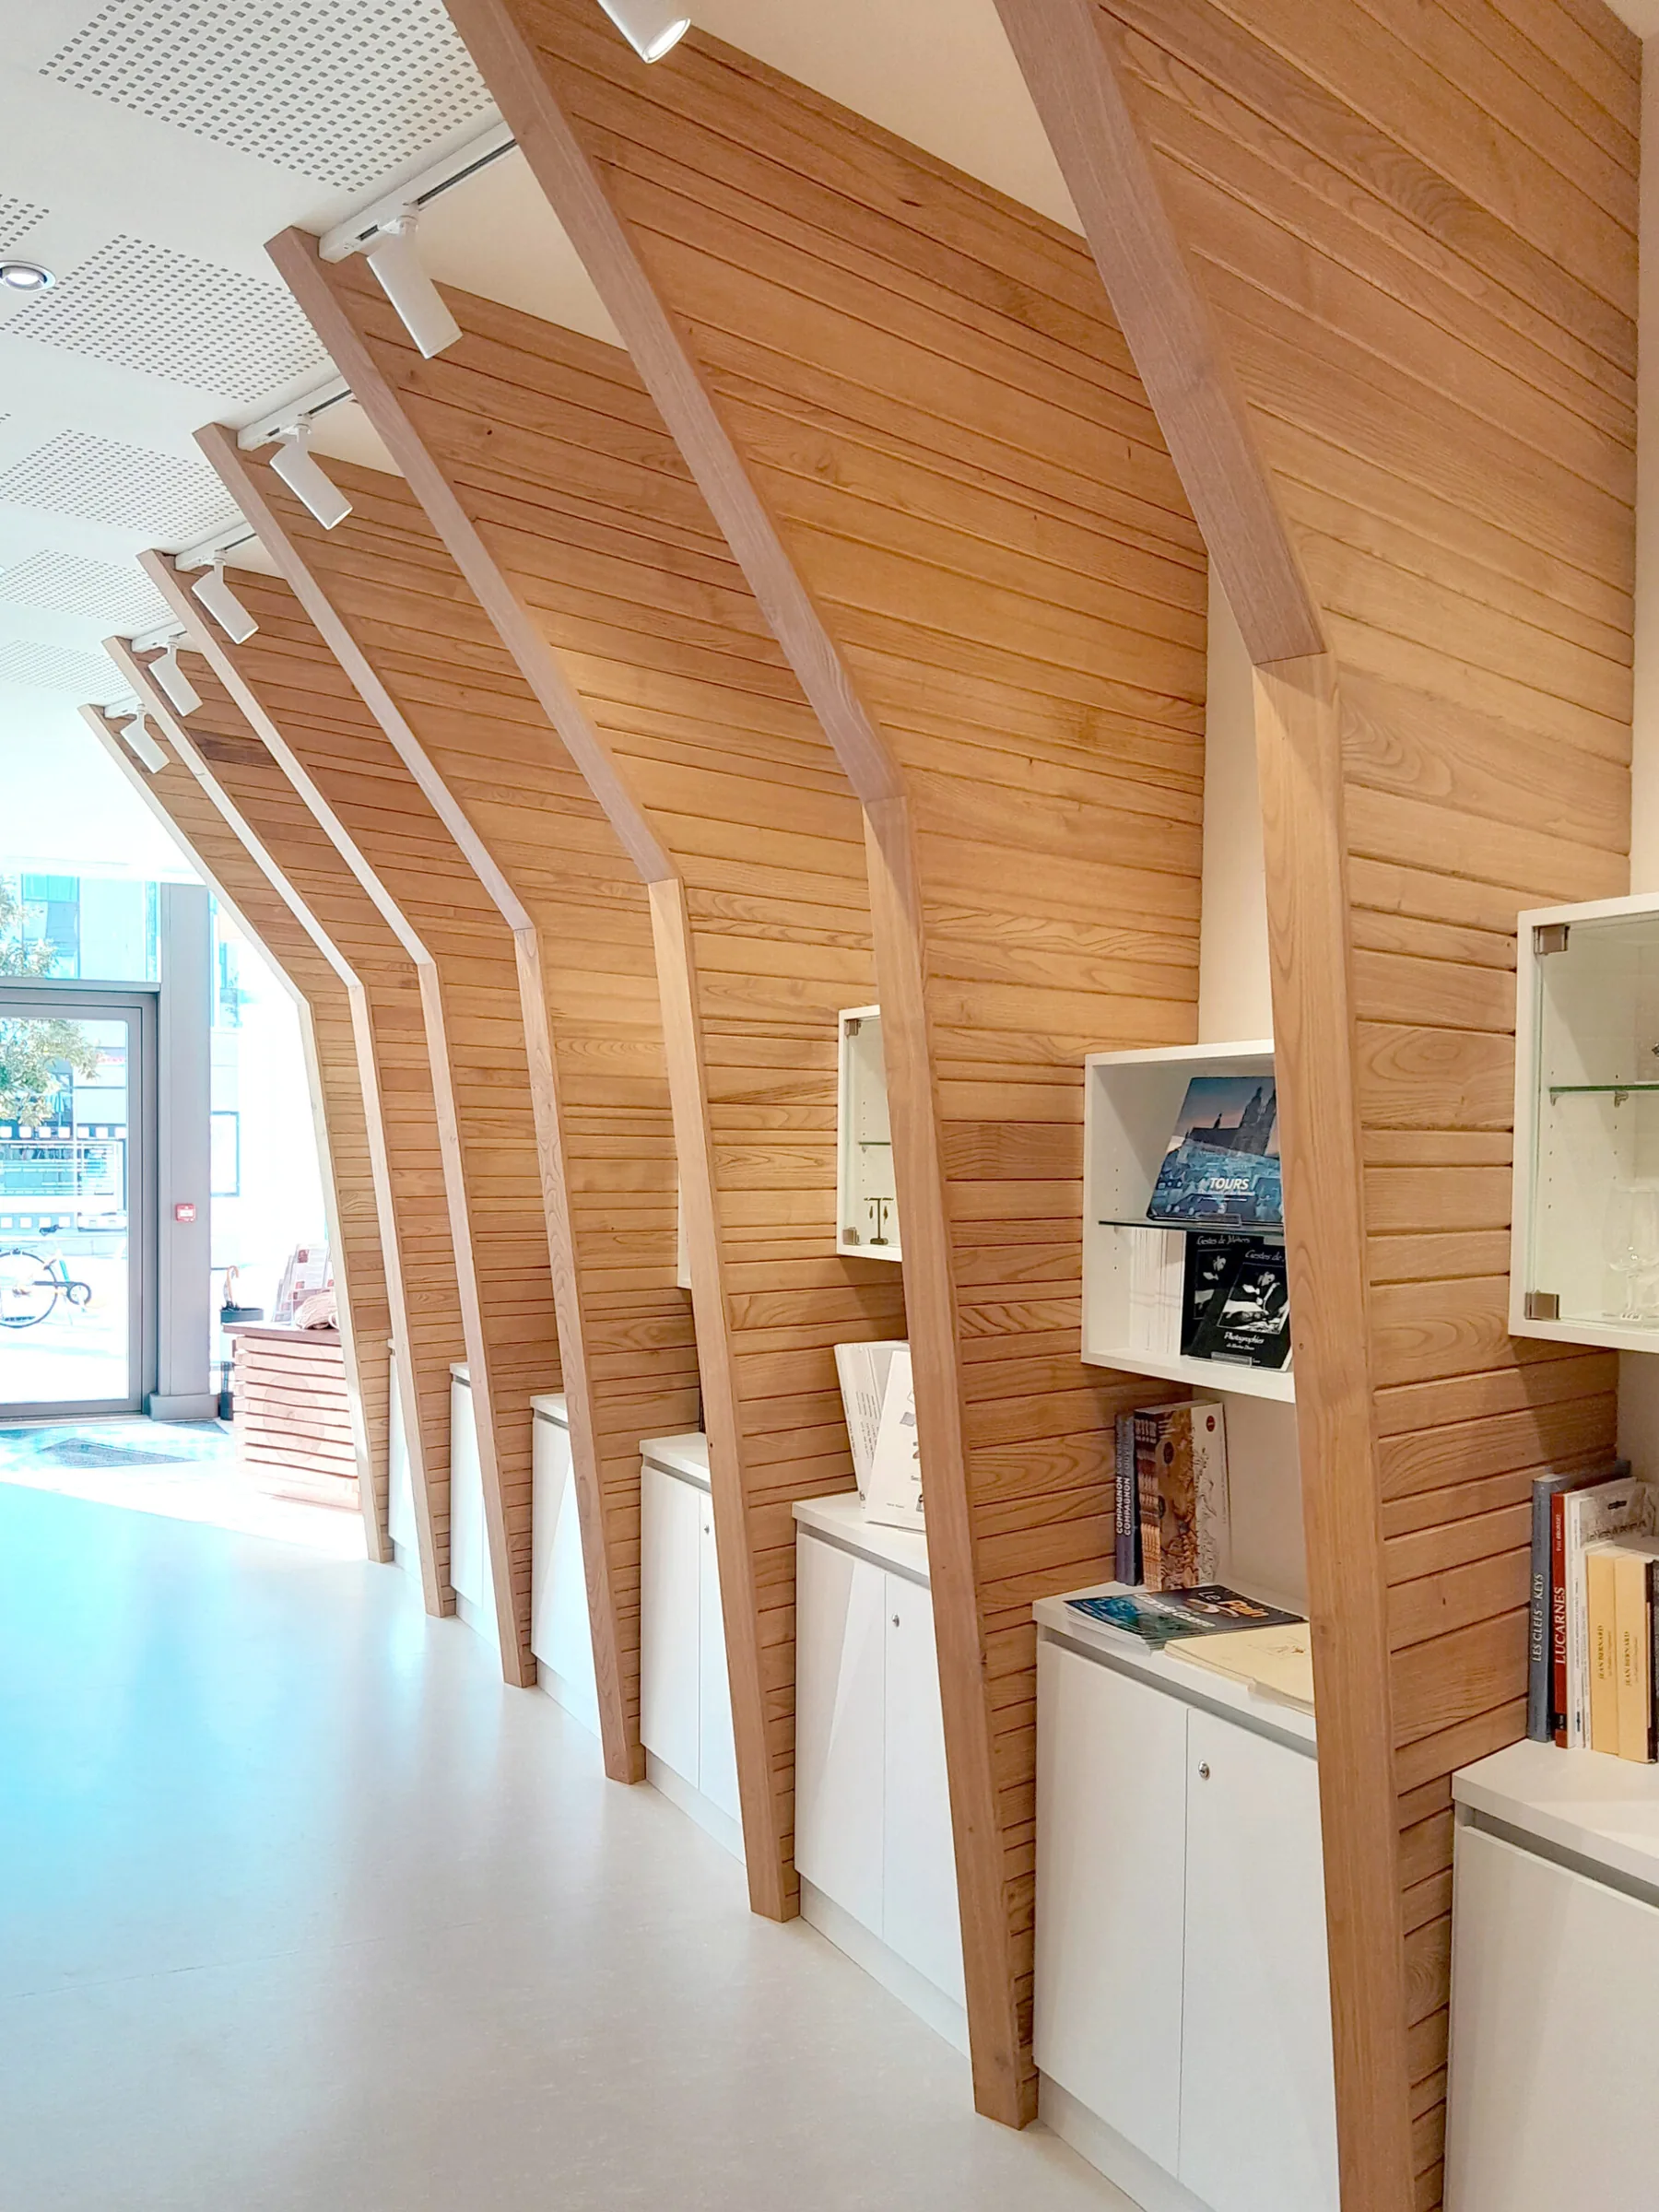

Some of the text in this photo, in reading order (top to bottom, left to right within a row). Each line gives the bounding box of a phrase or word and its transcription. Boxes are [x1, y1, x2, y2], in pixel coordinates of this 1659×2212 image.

[1209, 1177, 1250, 1190] TOURS
[1115, 1476, 1124, 1535] COMPAGNON
[1124, 1477, 1132, 1536] COMPAGNON
[1198, 1591, 1222, 1602] Le
[1533, 1572, 1544, 1600] KEYS
[1217, 1599, 1270, 1618] Pain
[1553, 1586, 1566, 1665] LUCARNES
[1532, 1644, 1543, 1663] LES
